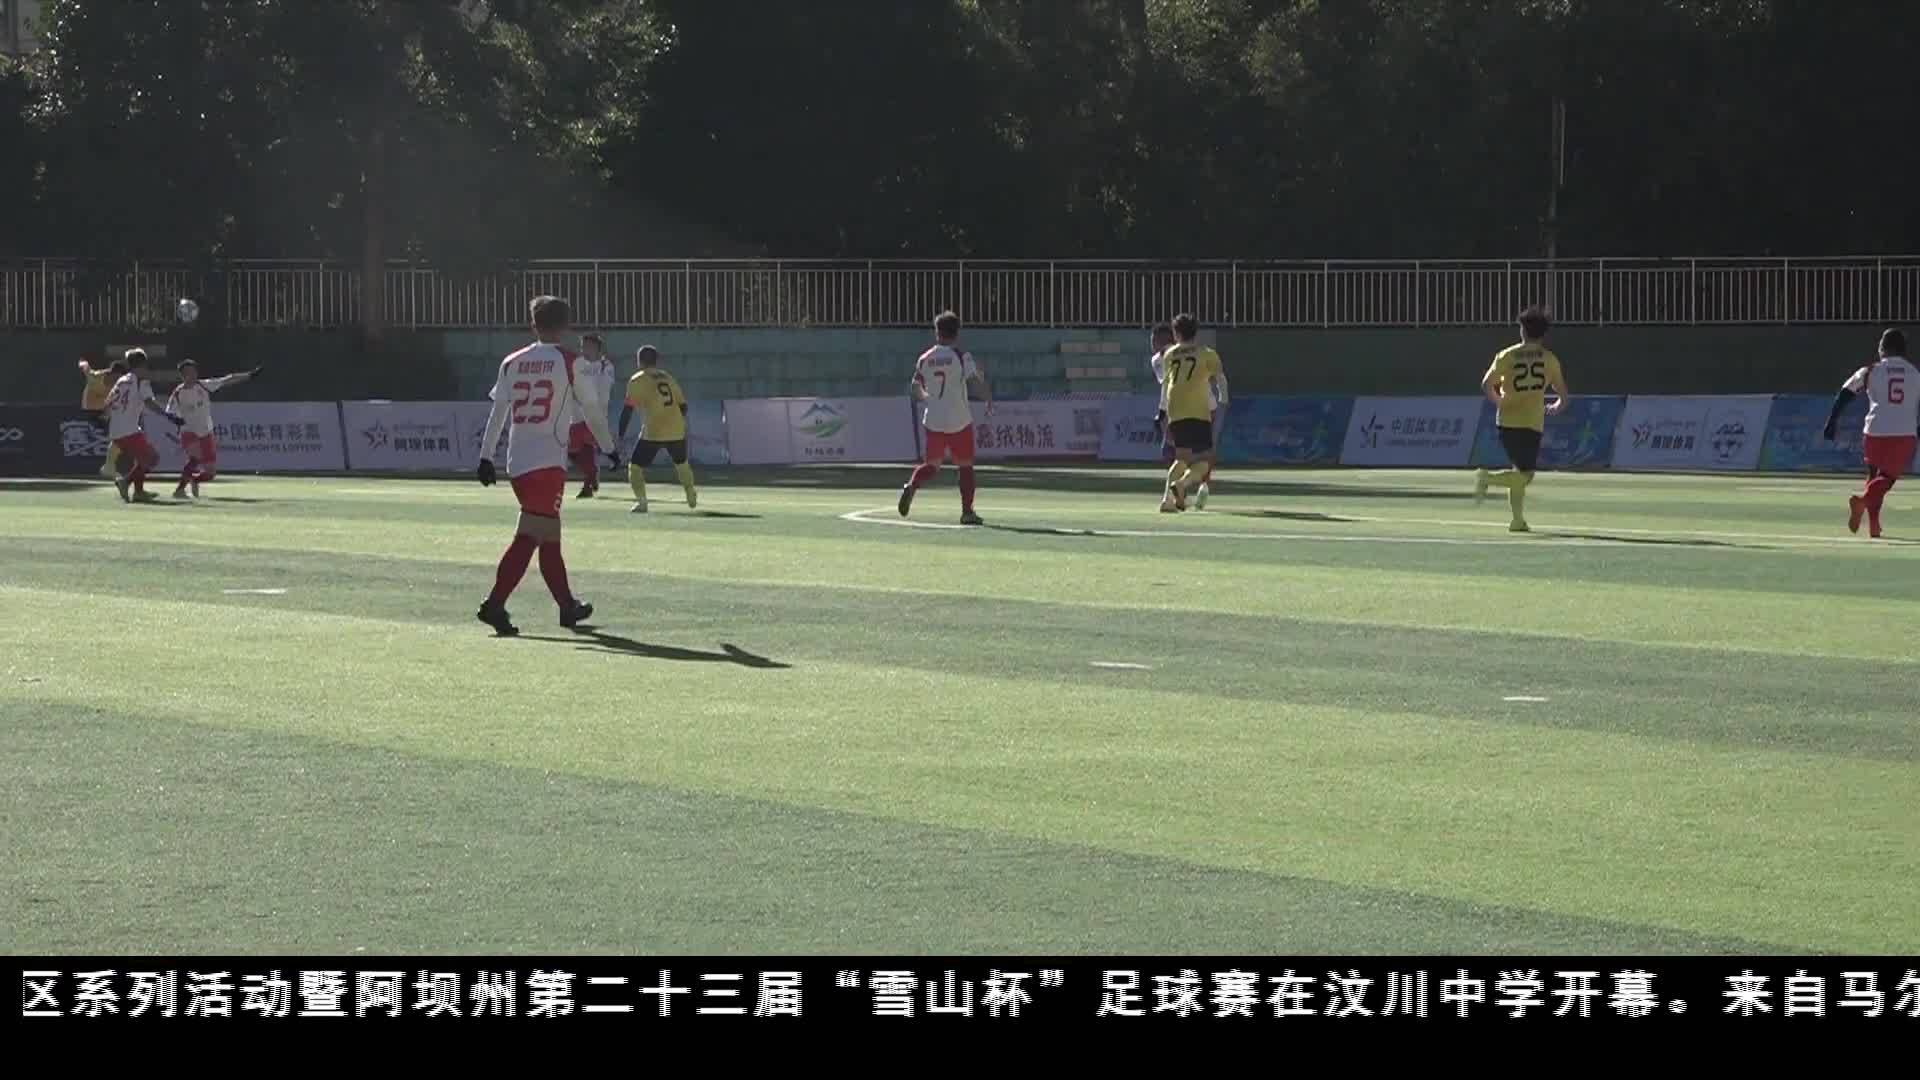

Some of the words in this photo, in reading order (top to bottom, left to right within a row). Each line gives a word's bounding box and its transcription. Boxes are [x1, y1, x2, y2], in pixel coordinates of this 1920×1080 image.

[1171, 356, 1197, 383] 77
[1513, 362, 1546, 392] 25
[657, 382, 674, 407] 9
[934, 371, 946, 399] 7
[1888, 378, 1905, 404] 6
[513, 380, 554, 424] 23
[213, 423, 320, 441] 中国体育彩票
